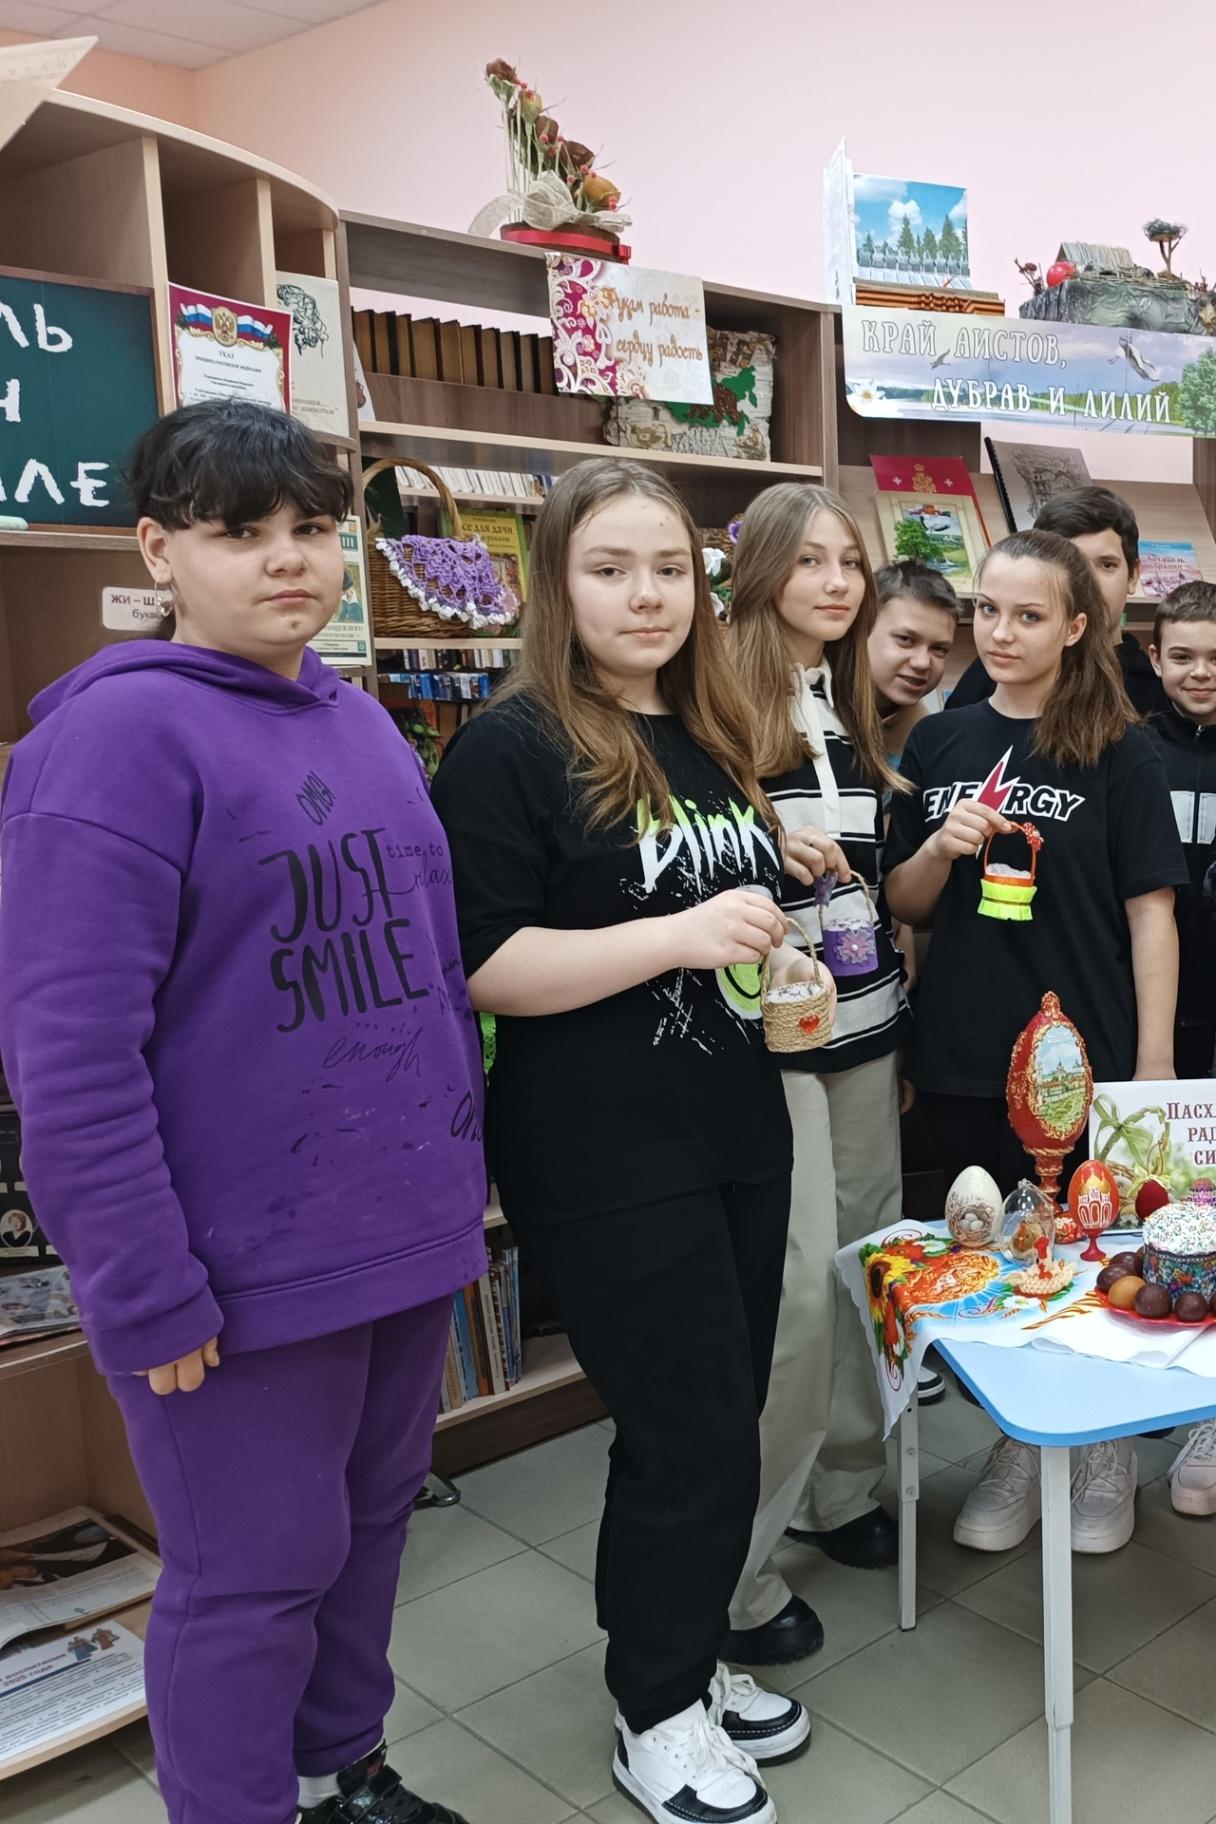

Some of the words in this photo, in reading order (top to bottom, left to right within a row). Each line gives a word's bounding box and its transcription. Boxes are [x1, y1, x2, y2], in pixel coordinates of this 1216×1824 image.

[649, 293, 690, 326] работа
[659, 334, 703, 368] радость
[861, 320, 937, 357] КРАЙ
[953, 328, 1067, 369] АИСТОВ,
[930, 377, 1032, 412] ДУБРАВ
[1049, 387, 1066, 415] И
[1083, 389, 1171, 424] ЛИЛИЙ
[922, 780, 1086, 823] ENERGY
[386, 843, 421, 859] time
[429, 841, 444, 857] to
[258, 827, 393, 944] JUST
[270, 918, 430, 1034] SMILE
[323, 1026, 421, 1083] enough
